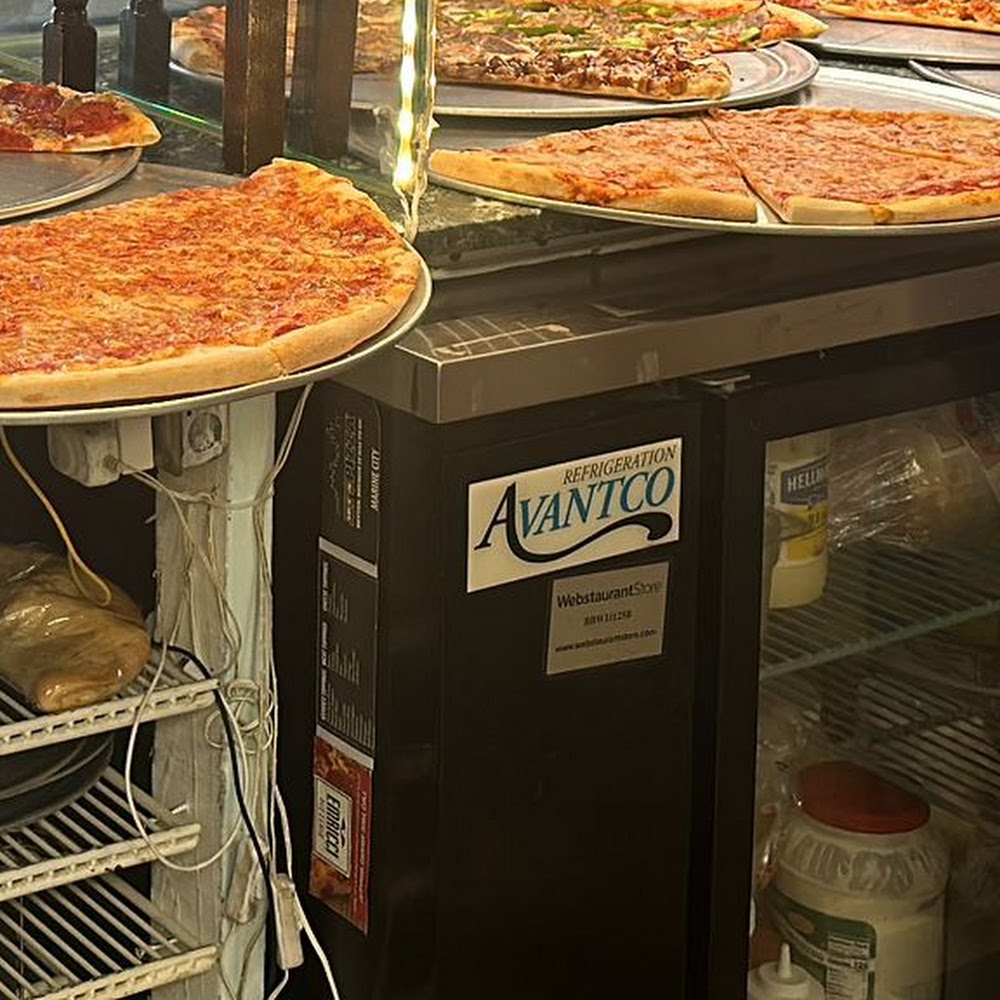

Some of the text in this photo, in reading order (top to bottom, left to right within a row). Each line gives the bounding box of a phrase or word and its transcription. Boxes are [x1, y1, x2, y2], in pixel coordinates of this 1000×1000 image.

[370, 448, 380, 511] MARINE CITY
[563, 445, 678, 484] REFRIGERATION
[474, 467, 676, 561] AVANTCO
[556, 581, 664, 608] WebstaurantStore
